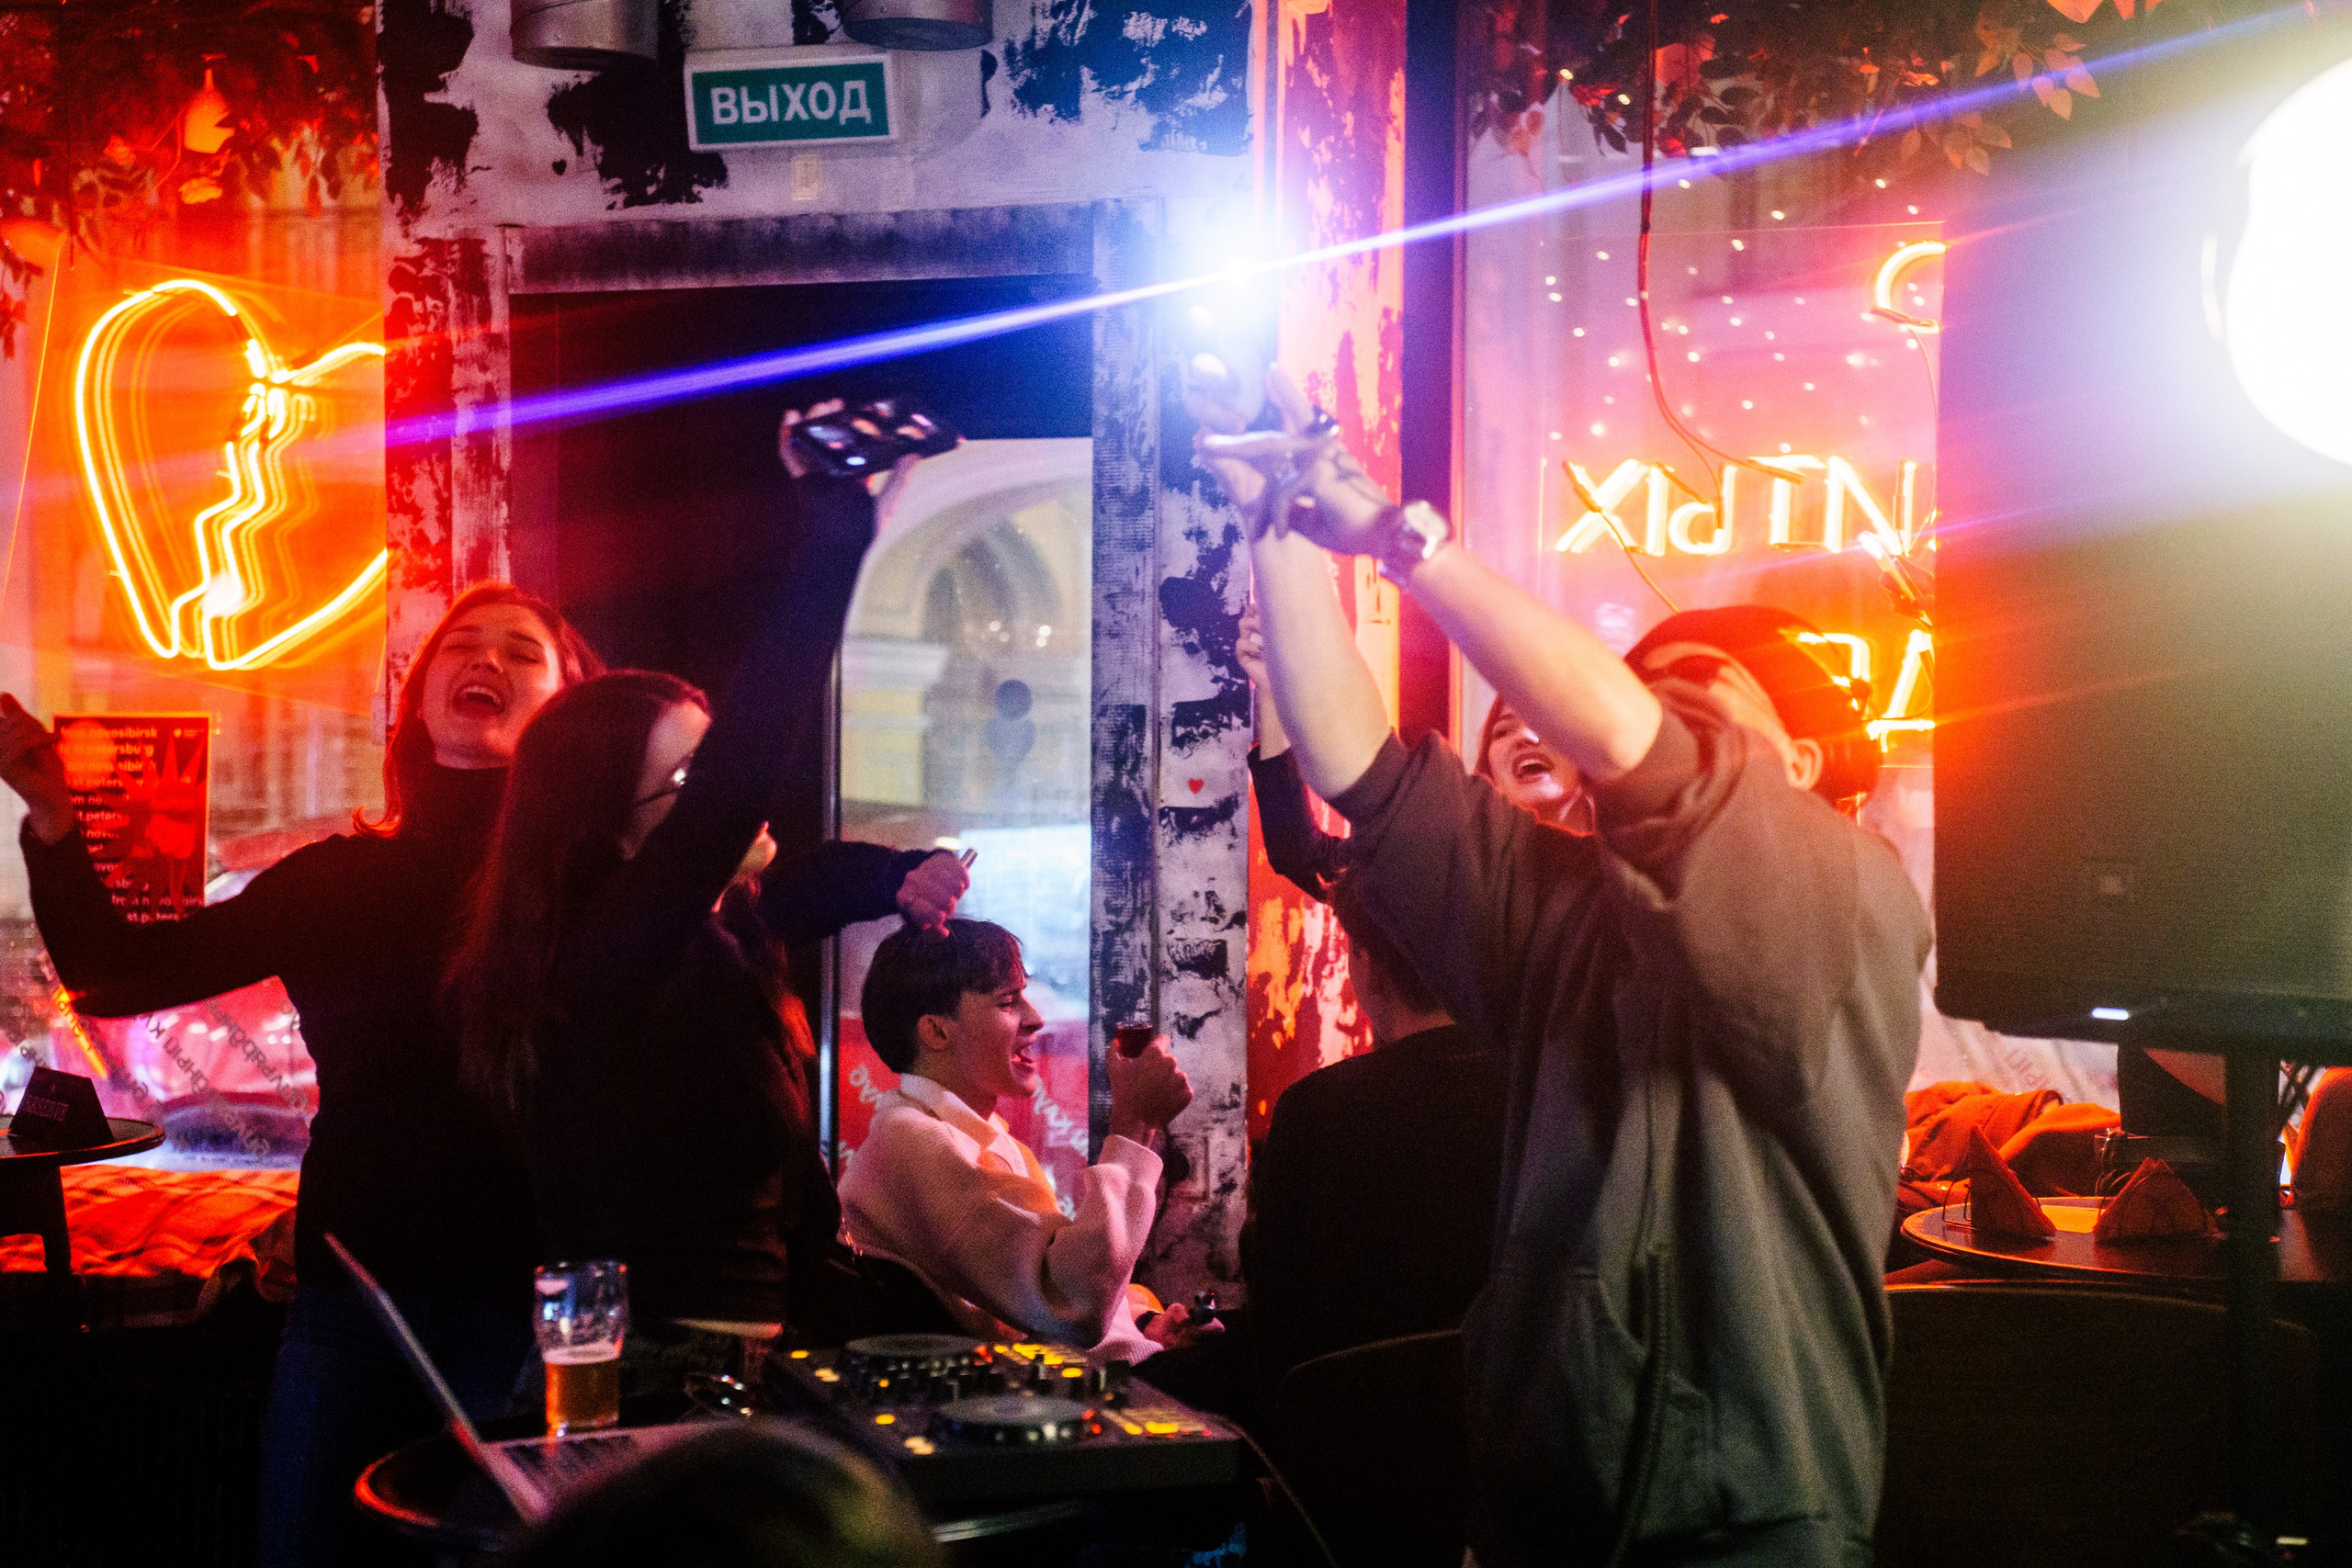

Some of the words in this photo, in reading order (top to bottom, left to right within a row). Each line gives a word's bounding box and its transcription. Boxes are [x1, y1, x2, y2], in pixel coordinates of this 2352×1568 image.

[710, 80, 872, 126] ВЫХОД
[88, 727, 157, 739] novosibirsk
[74, 744, 154, 758] st.petersbug
